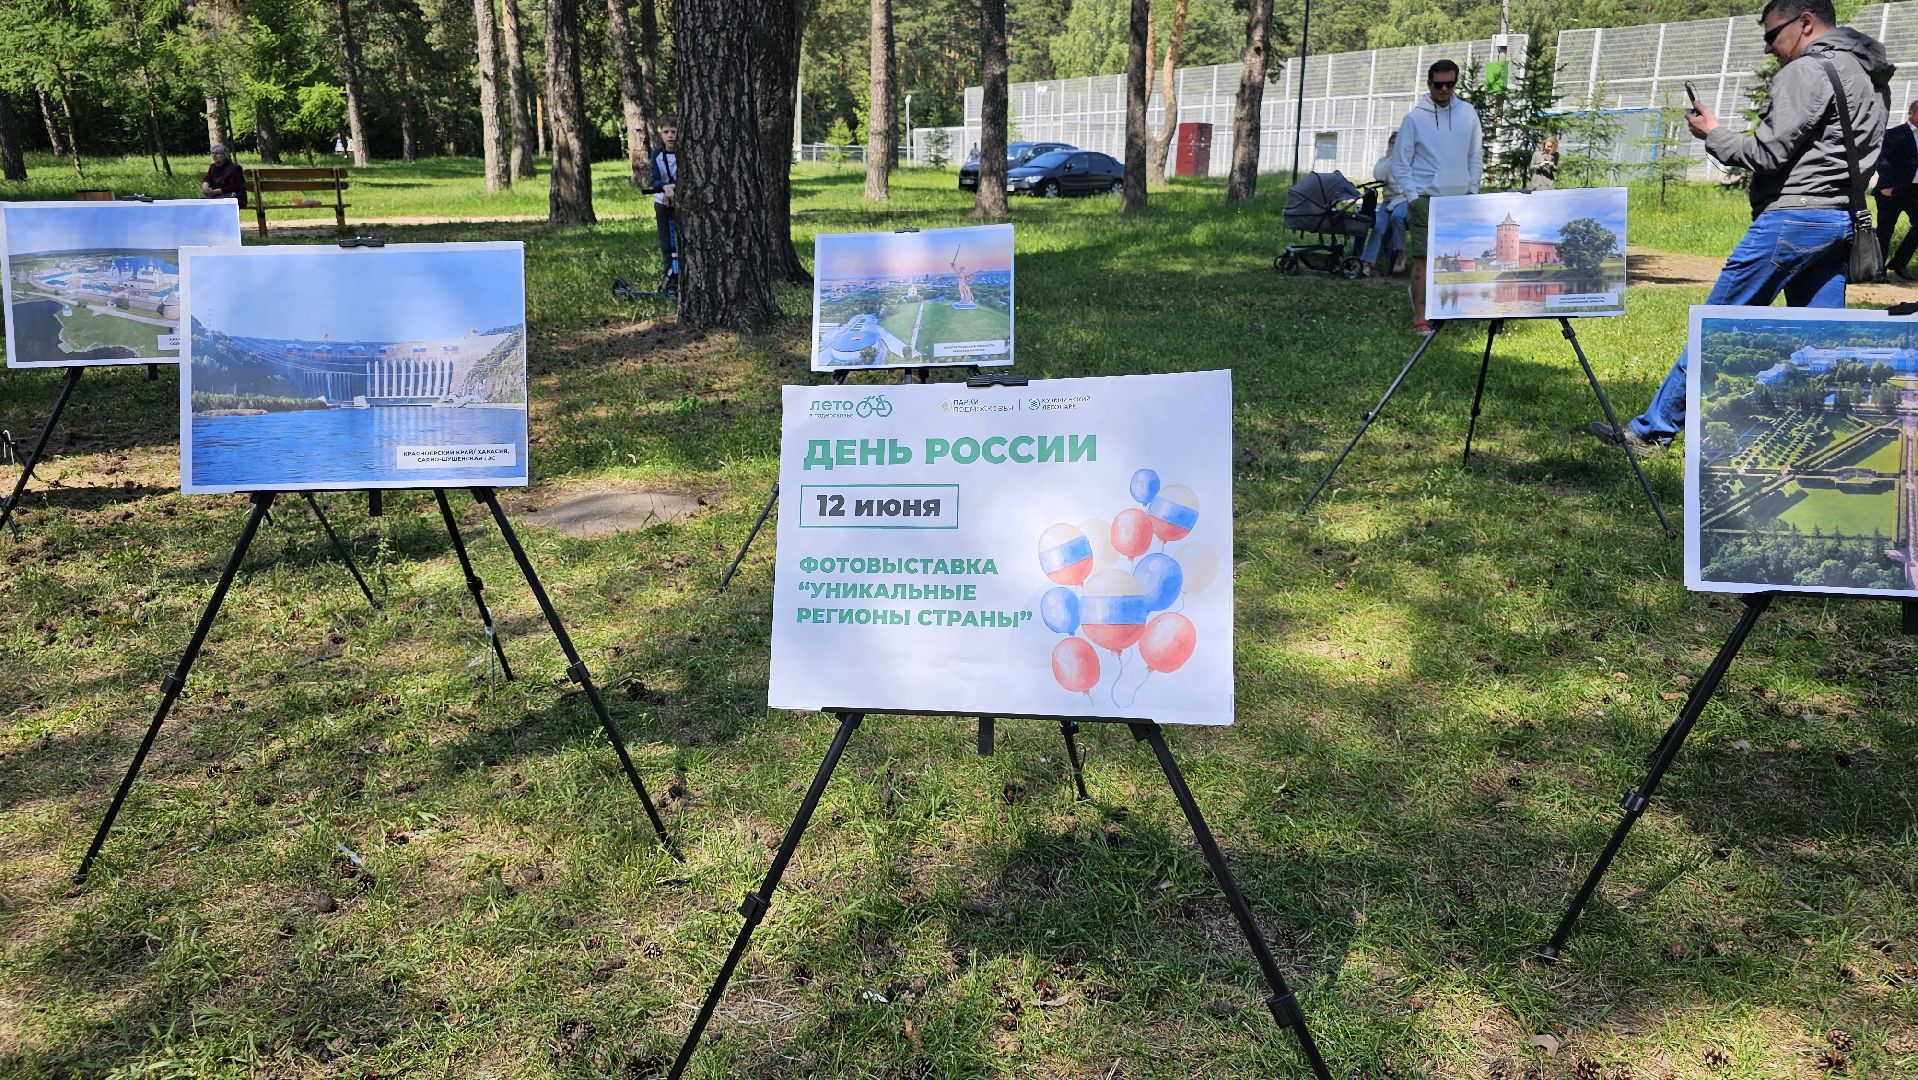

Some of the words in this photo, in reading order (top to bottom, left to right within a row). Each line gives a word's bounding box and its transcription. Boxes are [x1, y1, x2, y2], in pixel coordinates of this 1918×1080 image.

[953, 398, 979, 406] ПАРКИ
[803, 438, 913, 471] ДЕНЬ
[925, 434, 1098, 465] РОССИИ
[816, 494, 846, 517] 12
[854, 498, 941, 517] июня
[799, 557, 999, 575] ФОТОВЫСТАВКА
[796, 607, 910, 626] РЕГИОНЫ
